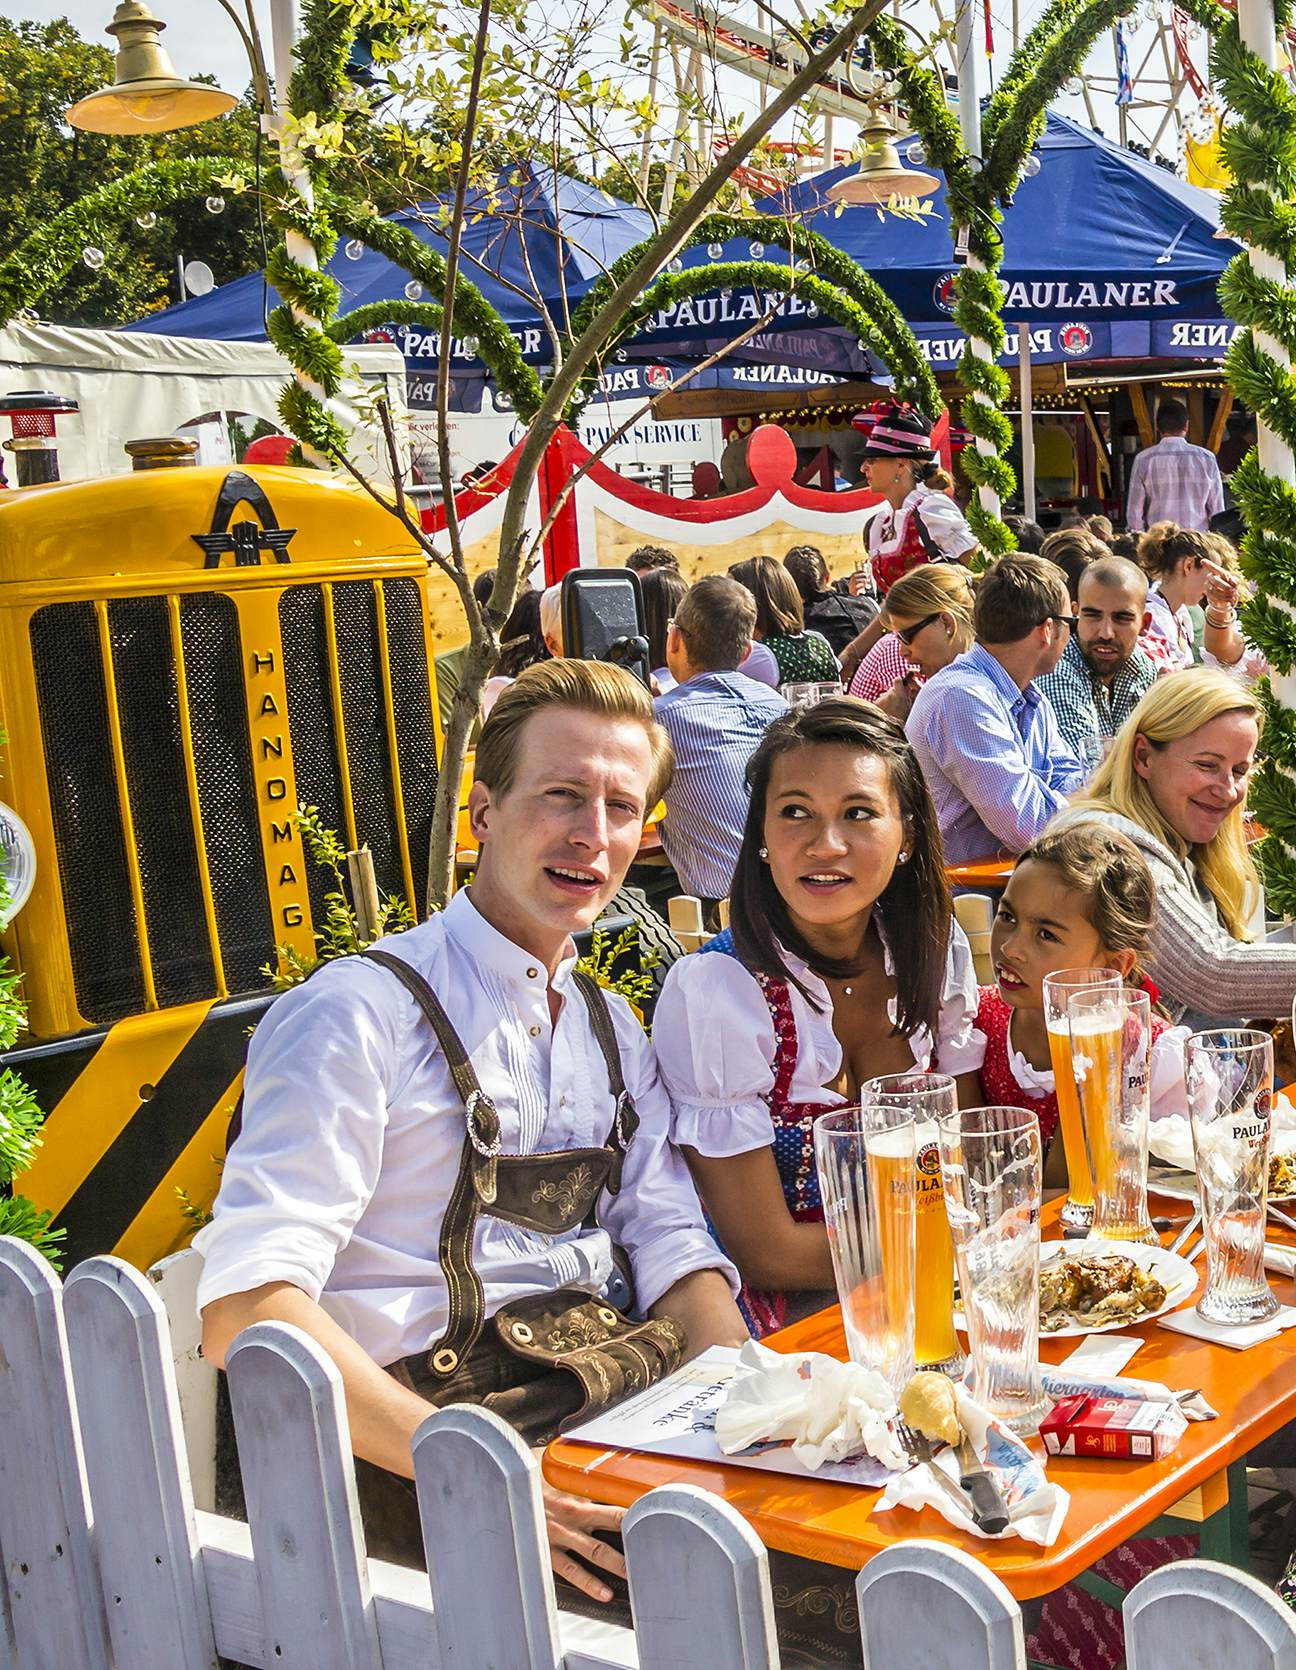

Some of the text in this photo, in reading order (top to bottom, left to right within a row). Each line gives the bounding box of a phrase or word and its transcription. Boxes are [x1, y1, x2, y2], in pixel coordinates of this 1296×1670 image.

[655, 290, 819, 329] PAULANE
[634, 423, 702, 444] SERVICE
[253, 649, 303, 928] HANOMAG
[1232, 1120, 1270, 1140] PAULA
[890, 1177, 944, 1194] PAULA
[652, 1376, 734, 1428] etränke
